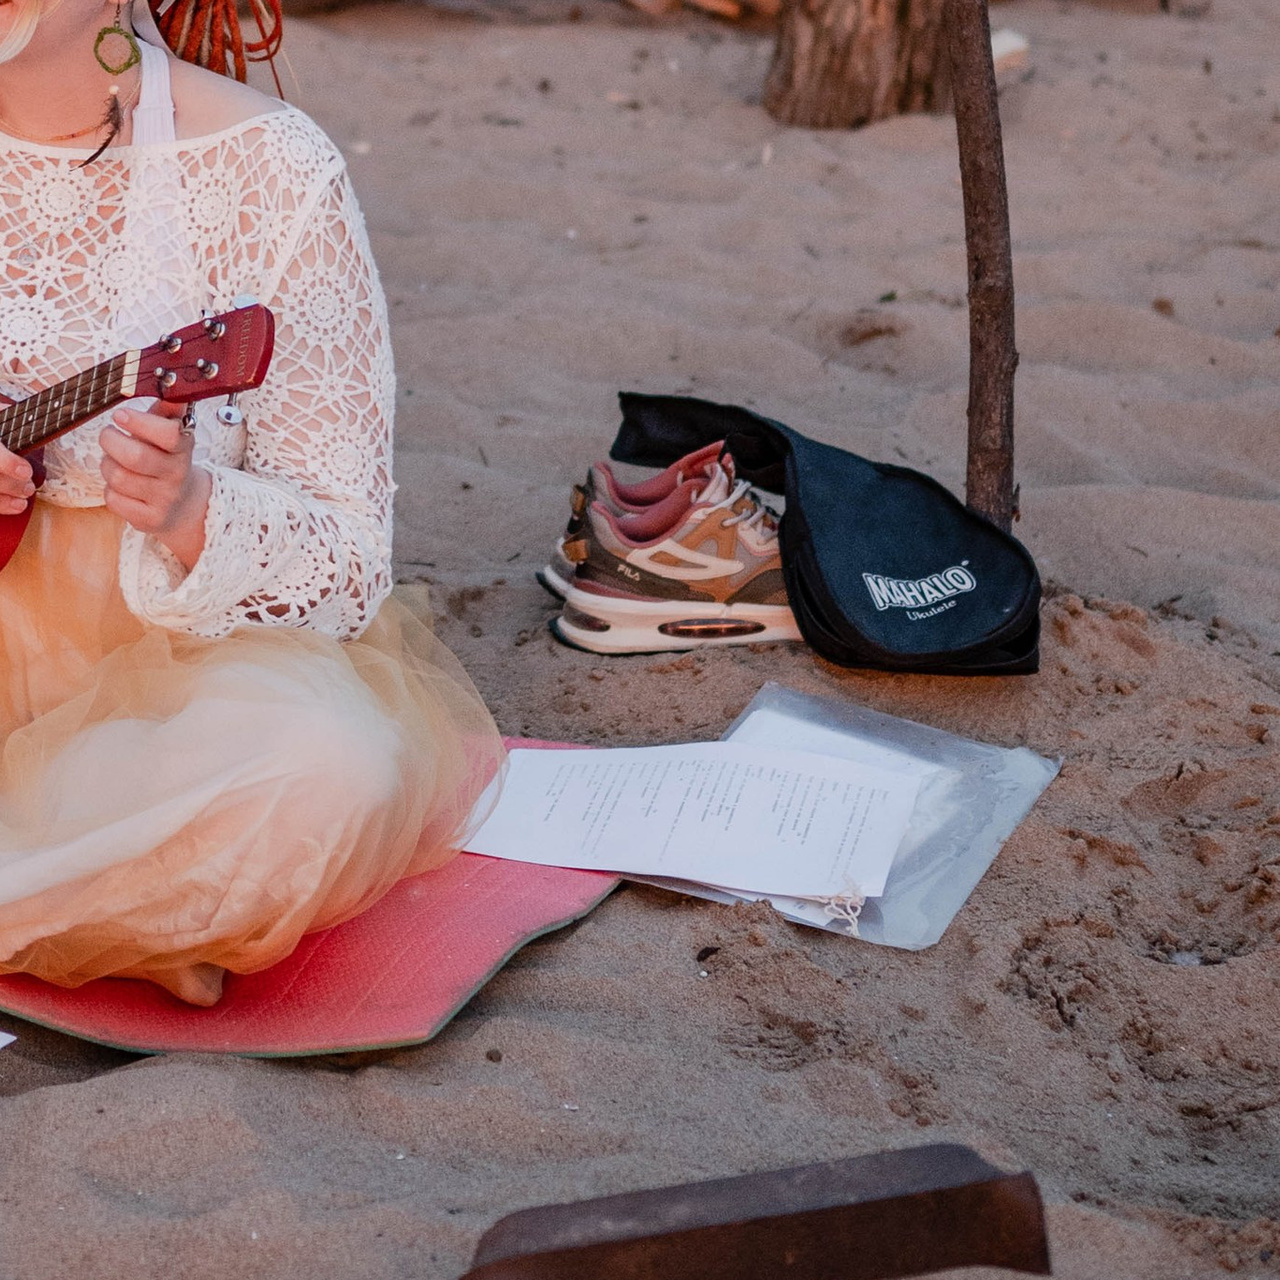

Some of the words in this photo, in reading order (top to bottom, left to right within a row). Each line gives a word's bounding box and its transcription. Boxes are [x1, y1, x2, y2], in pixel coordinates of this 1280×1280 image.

[237, 311, 253, 376] FREEDOM
[617, 564, 640, 581] FILA
[862, 566, 976, 611] MAHALO
[906, 600, 958, 621] Ukulele
